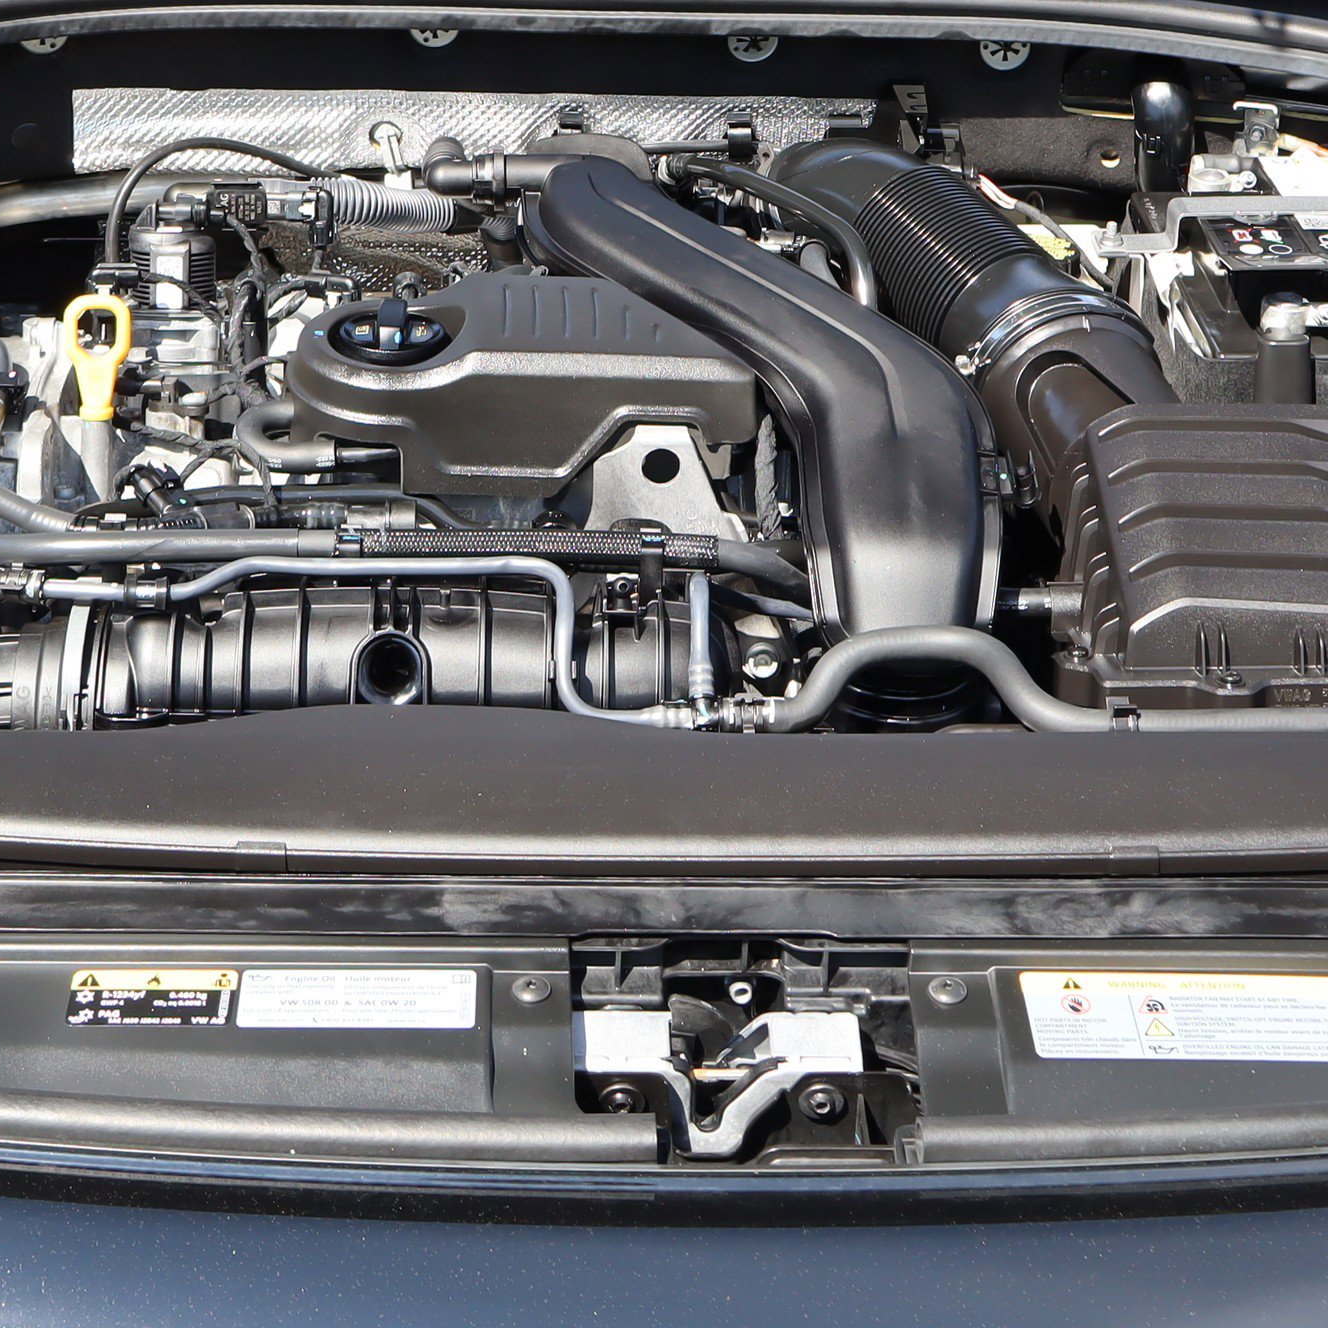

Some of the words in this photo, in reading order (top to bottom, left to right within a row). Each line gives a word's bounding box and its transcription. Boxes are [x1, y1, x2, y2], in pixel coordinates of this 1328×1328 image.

[102, 991, 147, 1000] R-1234yf
[196, 992, 208, 1001] kg
[98, 1010, 121, 1018] PAG
